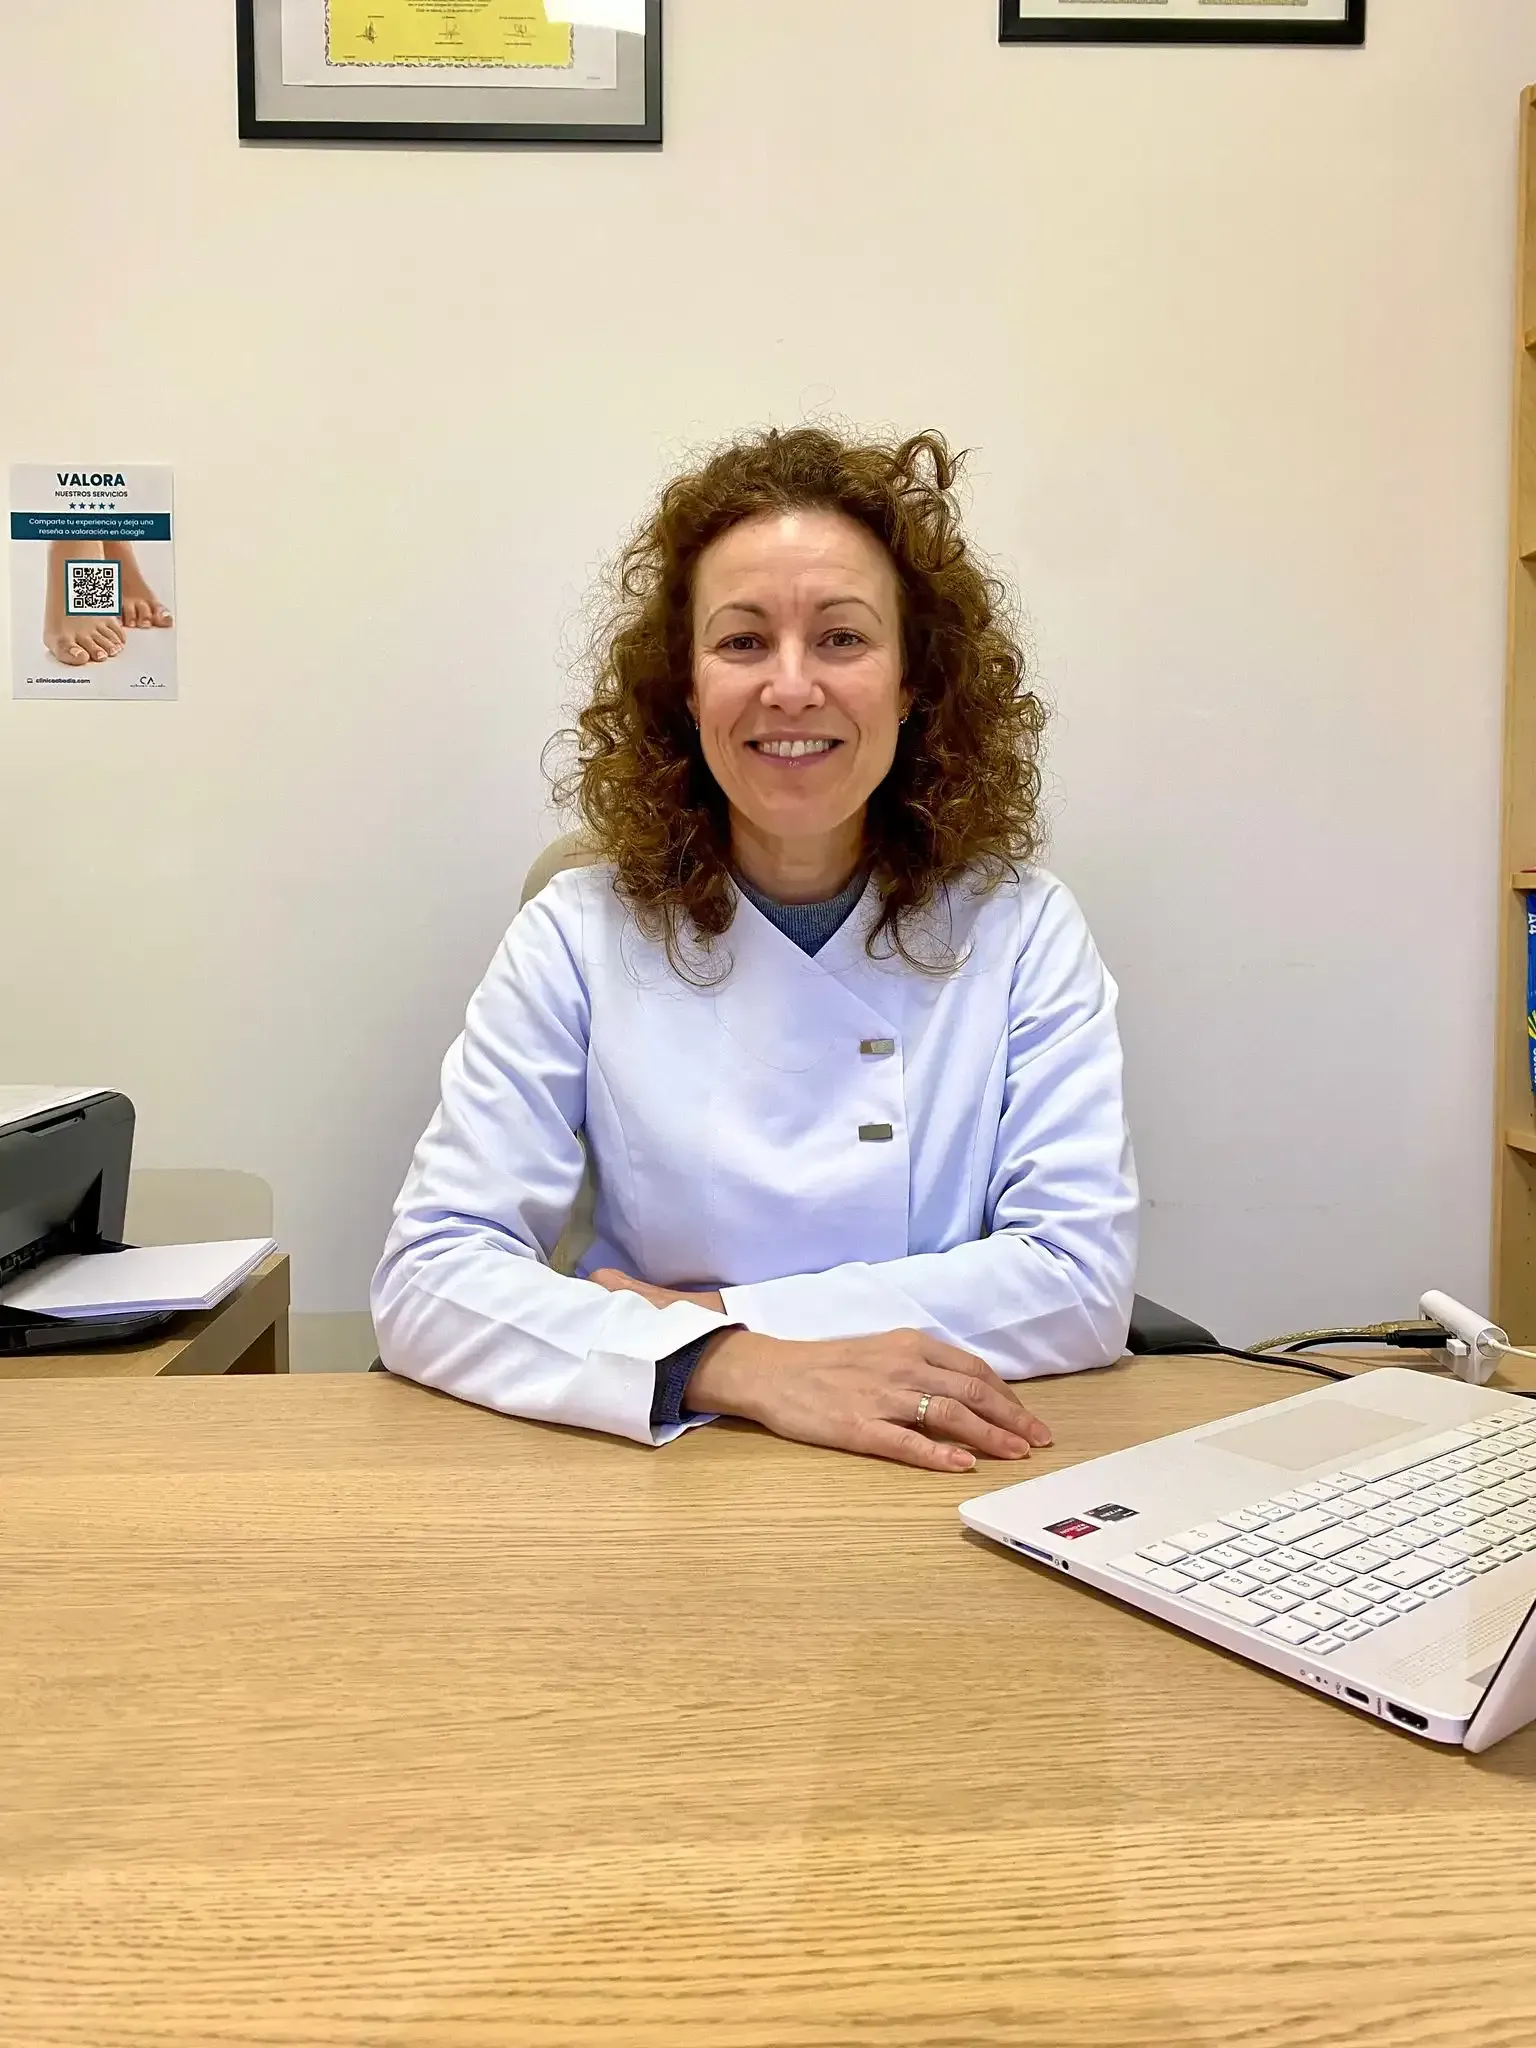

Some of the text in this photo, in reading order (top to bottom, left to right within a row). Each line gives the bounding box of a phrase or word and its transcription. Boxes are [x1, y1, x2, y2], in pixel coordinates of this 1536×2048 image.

[57, 473, 125, 486] VALORA
[29, 518, 66, 526] Comparte
[75, 519, 116, 527] experiencia
[124, 519, 138, 527] deja
[140, 677, 155, 685] CA
